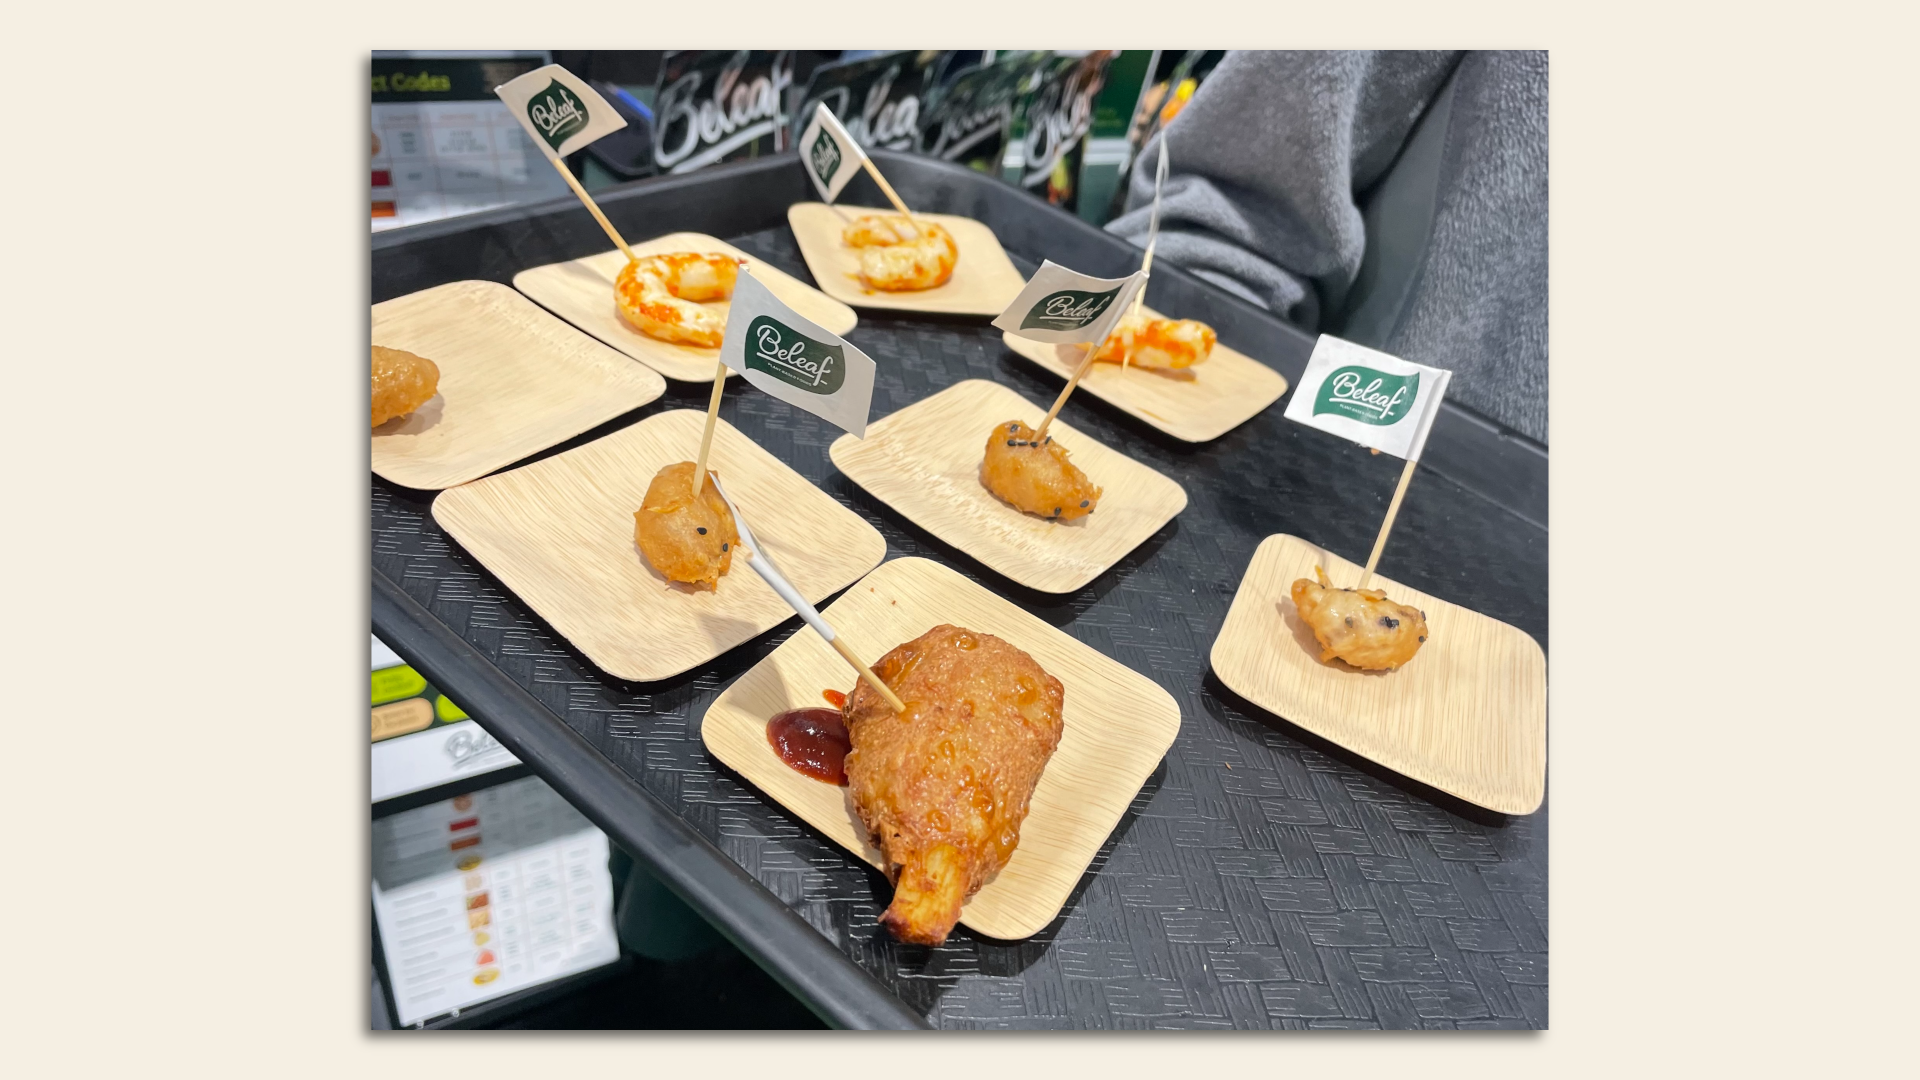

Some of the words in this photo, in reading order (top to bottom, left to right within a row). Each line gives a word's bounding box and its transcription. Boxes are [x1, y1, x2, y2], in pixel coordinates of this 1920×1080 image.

[391, 71, 451, 92] Codes
[531, 89, 583, 131] Beleaf
[1046, 295, 1111, 324] Beleaf
[757, 325, 834, 386] Beleaf
[1333, 372, 1406, 419] Beleaf
